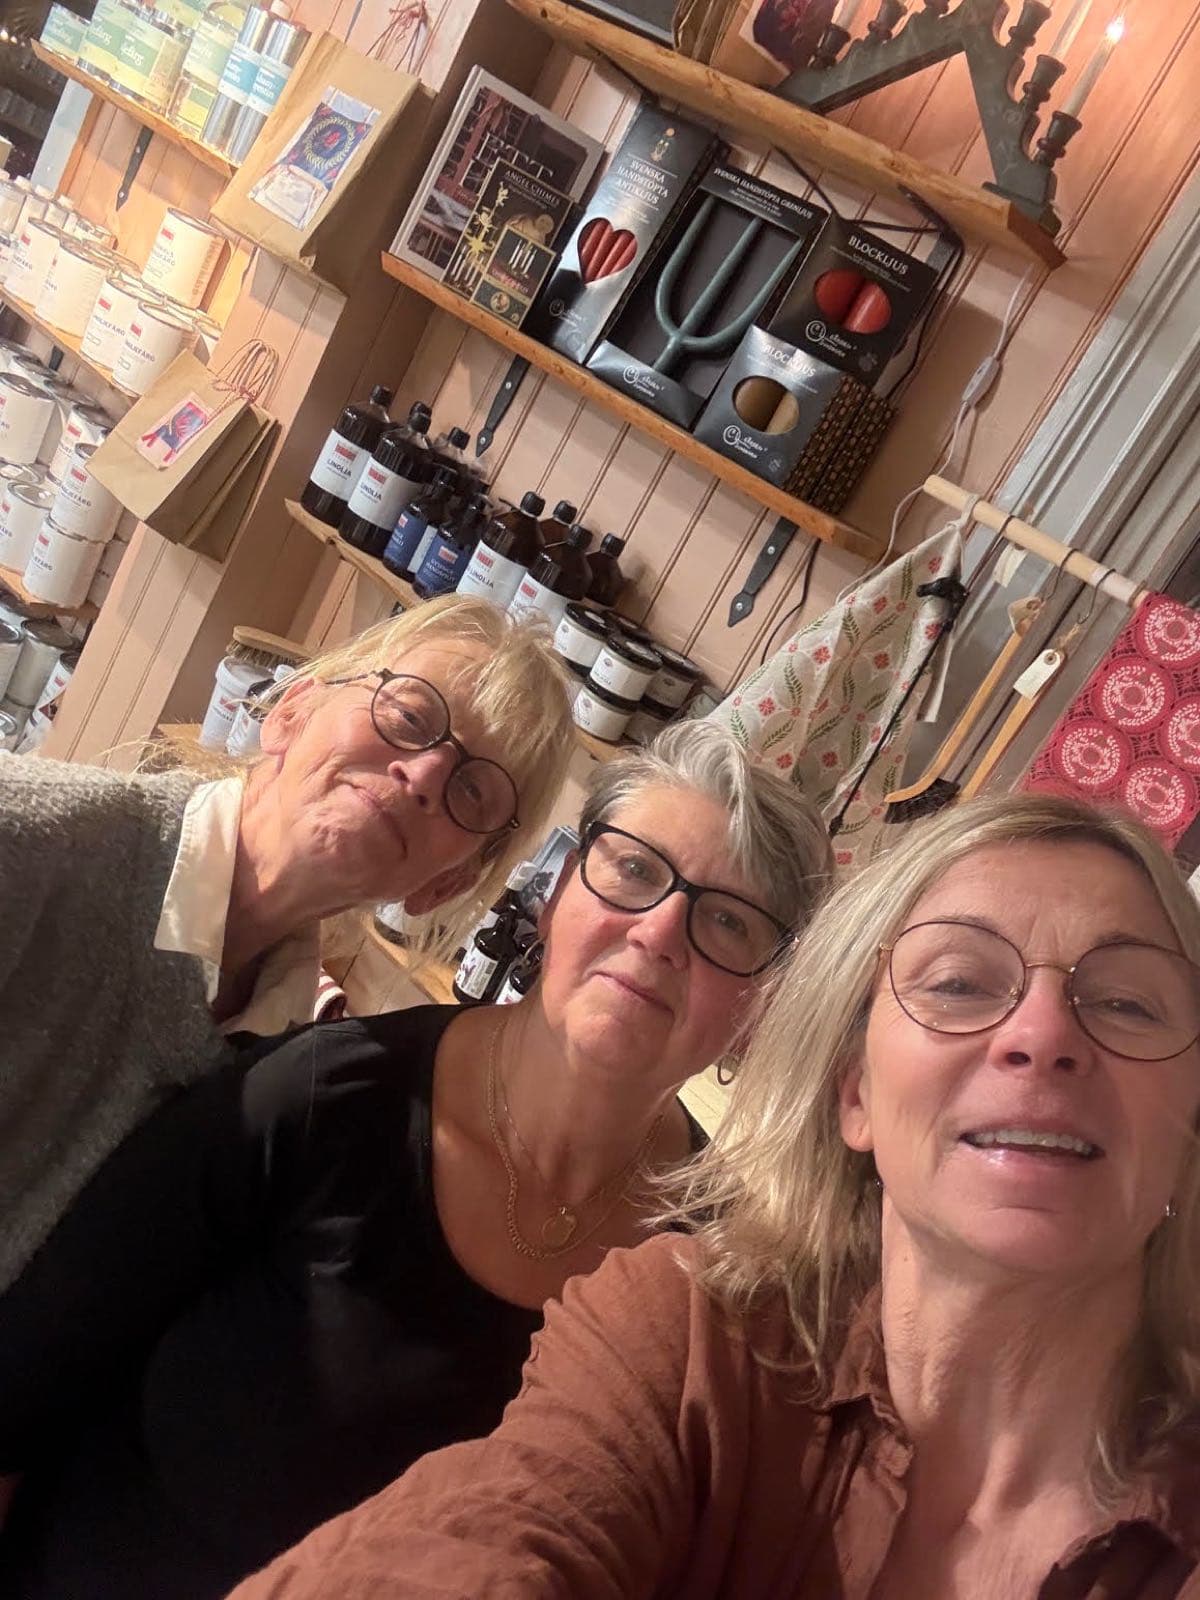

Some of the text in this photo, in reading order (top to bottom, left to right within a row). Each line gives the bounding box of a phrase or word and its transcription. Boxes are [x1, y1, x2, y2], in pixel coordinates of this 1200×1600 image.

[630, 159, 666, 183] SVENSKA
[713, 167, 740, 185] SVENSKA
[504, 170, 532, 192] ANGEL
[531, 184, 561, 208] CHIMES
[615, 179, 660, 206] ANTIKLJUS
[848, 234, 910, 276] BLOCKLJUS
[761, 344, 817, 378] BLOCKLJUS
